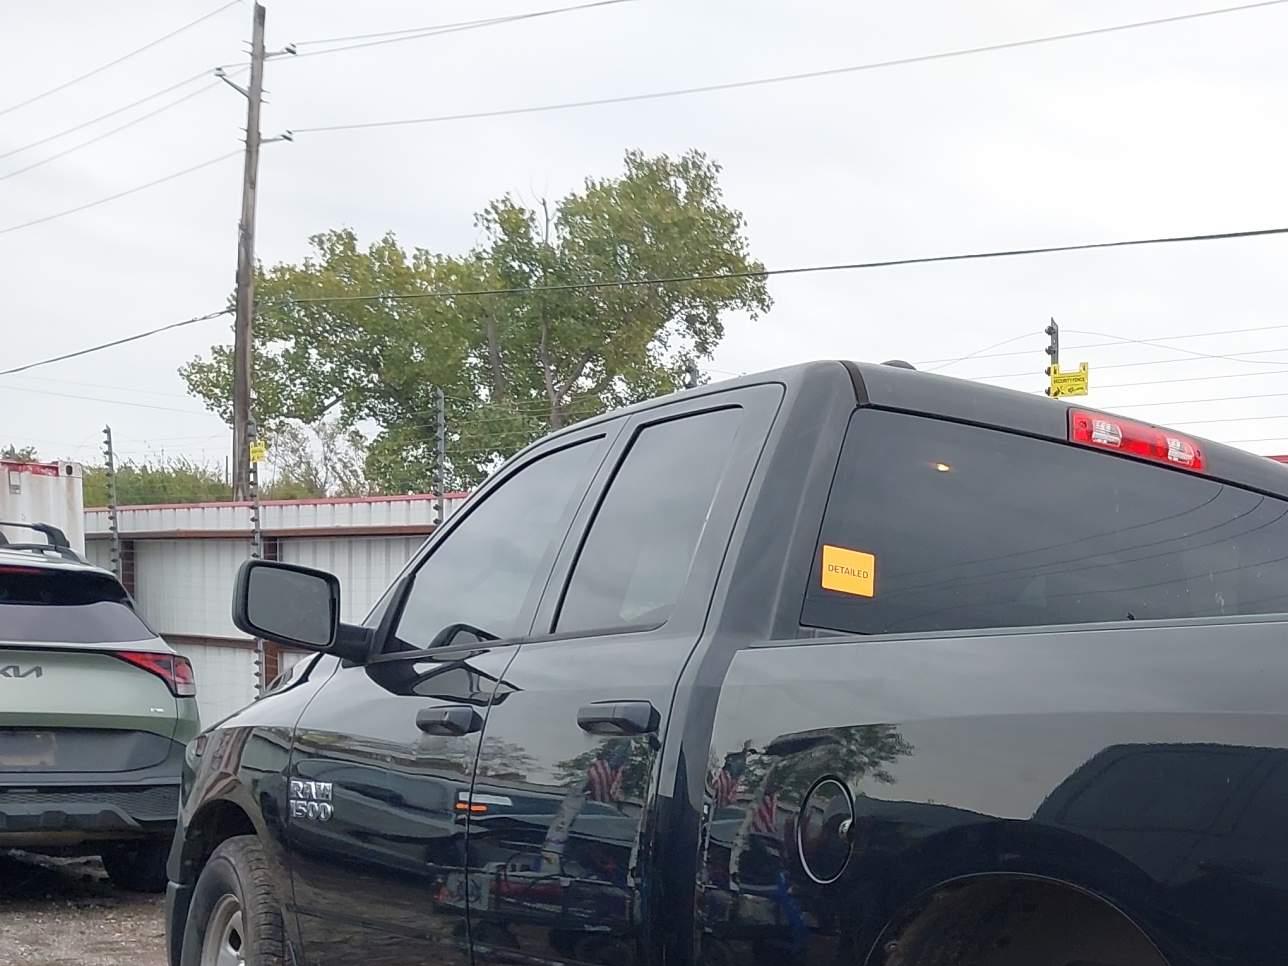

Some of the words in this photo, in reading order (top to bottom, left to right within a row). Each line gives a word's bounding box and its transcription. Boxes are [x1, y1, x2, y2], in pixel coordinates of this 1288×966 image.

[827, 563, 869, 579] DETAILED
[290, 780, 333, 800] RAM
[289, 799, 334, 820] 1500
